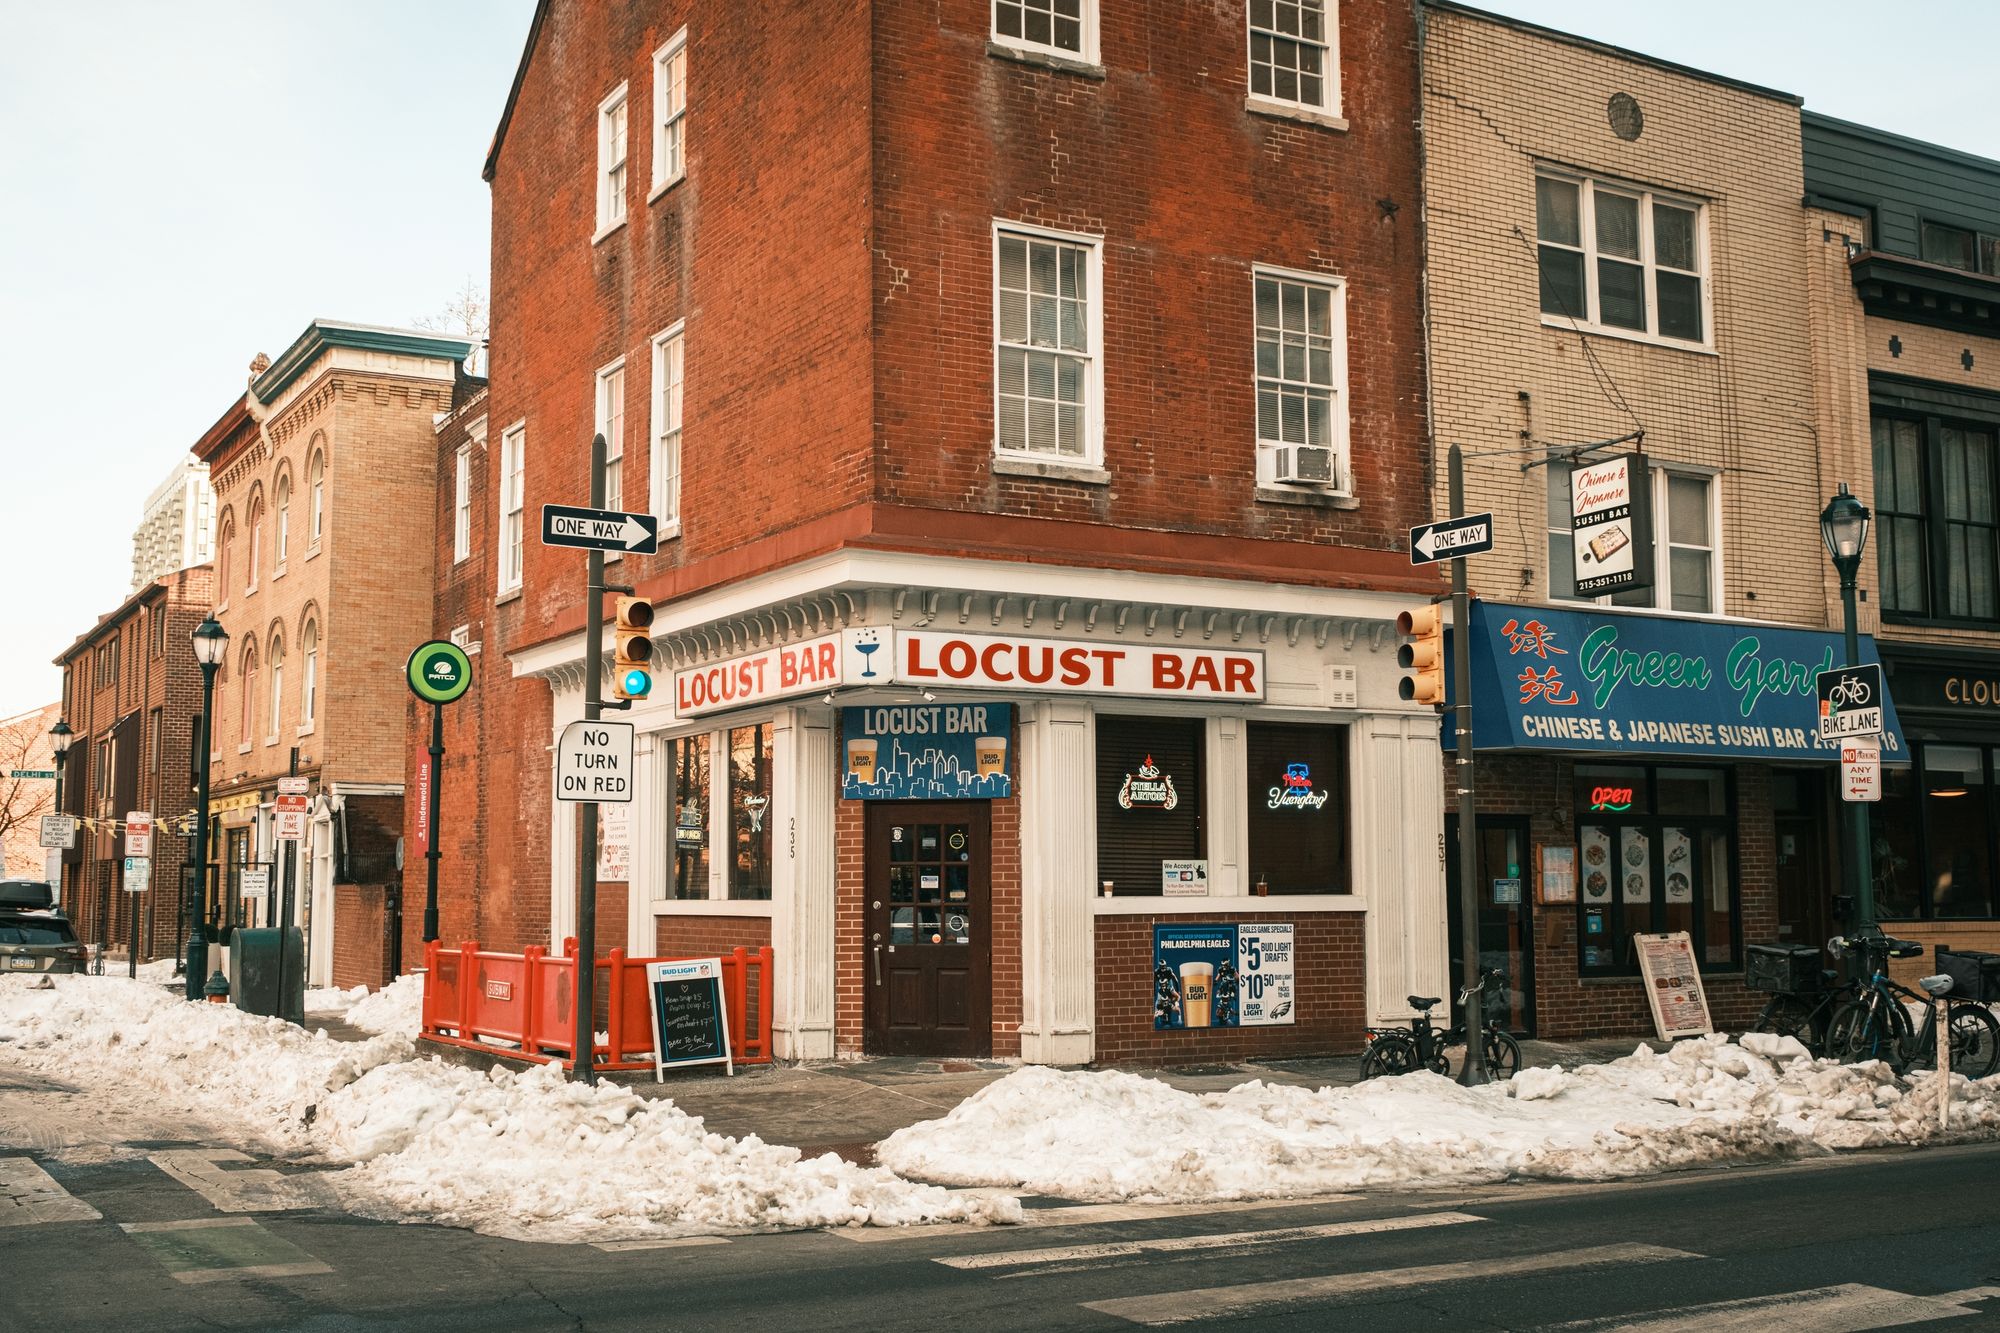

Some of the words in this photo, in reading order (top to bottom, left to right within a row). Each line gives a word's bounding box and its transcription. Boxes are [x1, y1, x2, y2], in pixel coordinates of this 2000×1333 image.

[1578, 470, 1616, 490] Chinese
[1618, 467, 1625, 480] &
[1577, 488, 1624, 514] Japanese
[1576, 512, 1605, 527] SUSHI
[1609, 507, 1629, 520] BAR
[556, 518, 587, 535] ONE
[592, 521, 624, 539] WAY
[1434, 532, 1456, 549] ONE
[1459, 526, 1483, 544] WAY
[1579, 572, 1633, 590] 215-351-1118
[908, 638, 1126, 687] LOCUST
[1152, 653, 1257, 693] BAR
[1580, 625, 1712, 710] Green
[679, 657, 769, 710] LOCUST
[781, 642, 836, 688] BAR
[864, 707, 941, 735] LOCUST
[946, 706, 988, 734] BAR
[1823, 716, 1846, 734] BIKE
[1851, 712, 1879, 731] LANE
[584, 731, 609, 746] NO
[1522, 715, 1605, 740] CHINESE
[1608, 719, 1623, 741] &
[1628, 720, 1716, 745] JAPANESE
[1717, 724, 1770, 747] SUSHI
[1772, 727, 1809, 749] BAR
[575, 753, 618, 770] TURN
[1843, 751, 1855, 761] NO
[1856, 751, 1877, 760] PARKING
[14, 770, 41, 778] DELHI
[420, 763, 428, 780] Line
[1850, 766, 1872, 774] ANY
[564, 776, 586, 791] ON
[594, 777, 626, 792] RED
[1131, 782, 1167, 791] STELLA
[1850, 776, 1873, 784] TIME
[1130, 791, 1166, 801] ARTOIS
[1268, 787, 1328, 809] Yuengling
[278, 804, 305, 812] STOPPING
[419, 783, 427, 828] Lindenwold
[283, 821, 298, 829] TIME
[126, 859, 132, 870] 2
[1240, 925, 1257, 933] EAGLES
[1257, 925, 1270, 933] GAME
[1271, 925, 1292, 933] SPECIALS
[1161, 940, 1206, 949] PHILADELPHIA
[1207, 939, 1231, 948] EAGLES
[1261, 942, 1273, 952] BUD
[1274, 942, 1292, 952] LIGHT
[1240, 937, 1260, 971] $5
[1264, 953, 1288, 962] DRAFTS
[677, 967, 697, 975] LIGHT
[488, 984, 508, 997] SUBWAY
